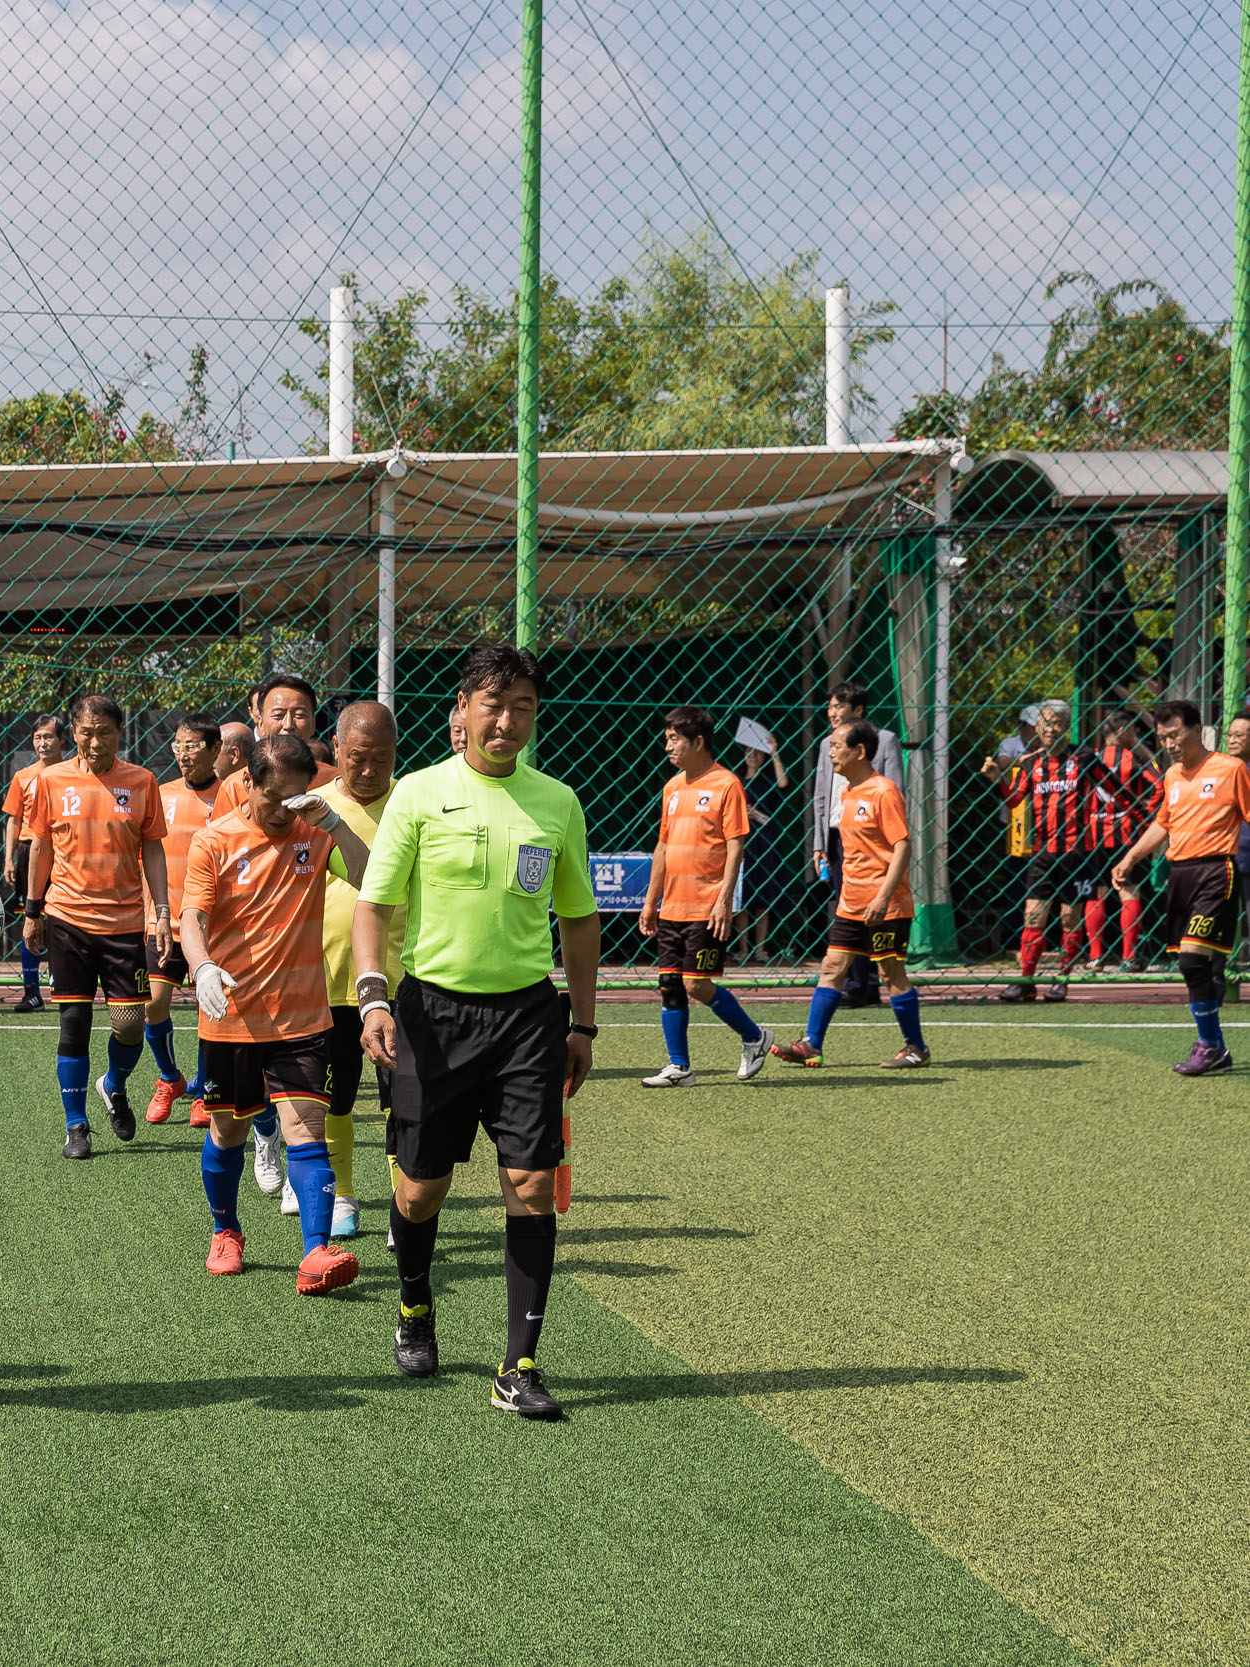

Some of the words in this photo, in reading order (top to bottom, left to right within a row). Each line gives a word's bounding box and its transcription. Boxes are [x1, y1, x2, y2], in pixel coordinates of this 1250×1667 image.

[112, 787, 132, 797] SEOUL
[61, 796, 82, 817] 12
[165, 804, 177, 824] 4
[520, 846, 552, 858] REFEREE
[236, 859, 252, 885] 2
[1073, 880, 1093, 896] 16
[1187, 914, 1215, 938] 13
[696, 948, 719, 971] 19
